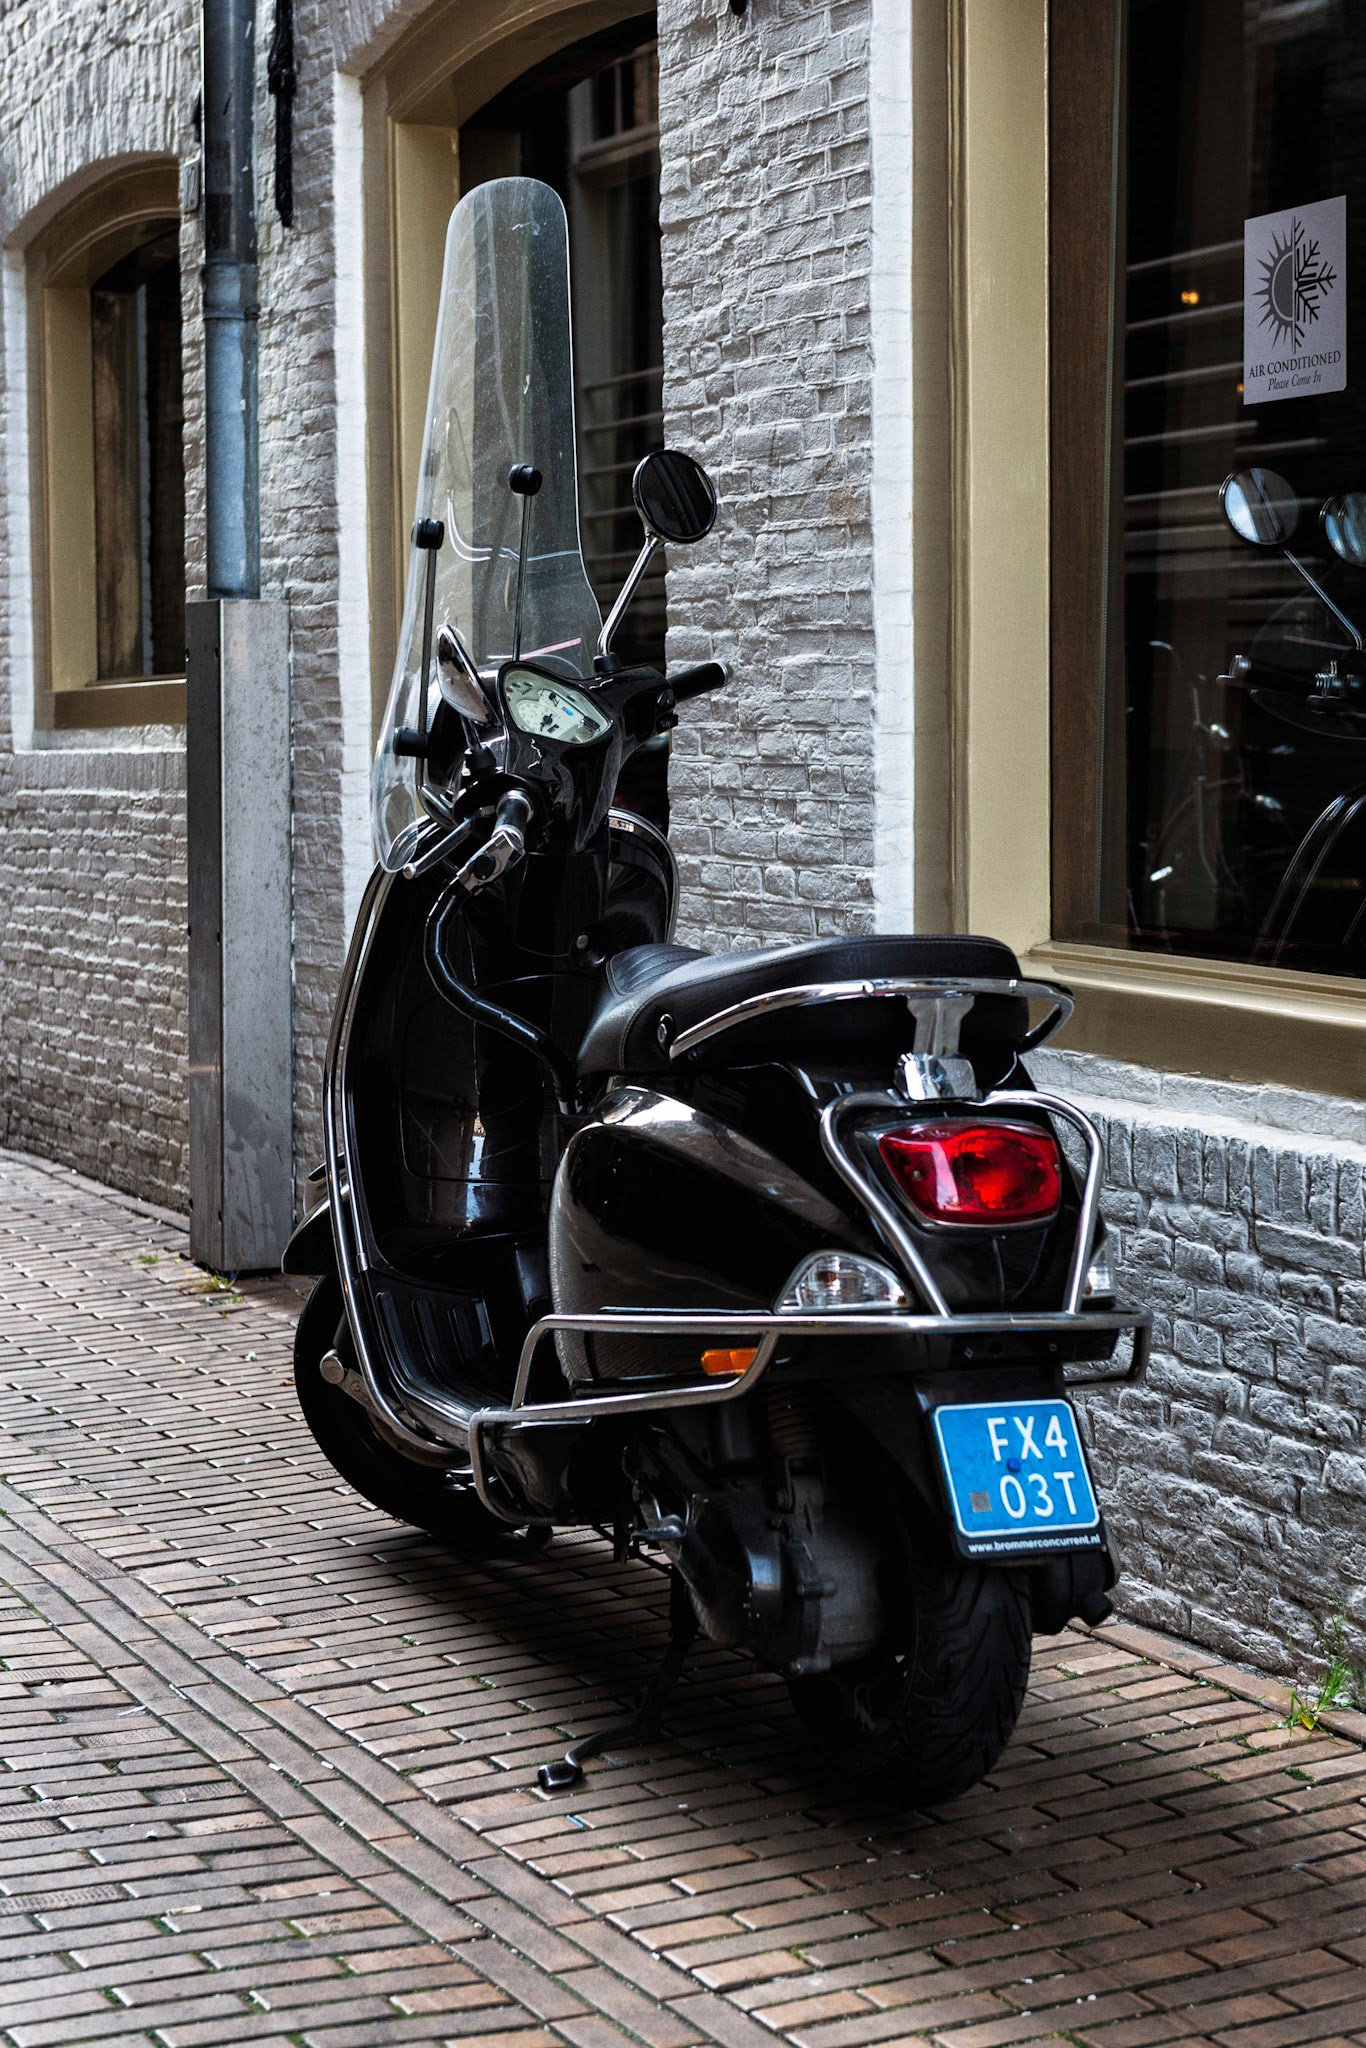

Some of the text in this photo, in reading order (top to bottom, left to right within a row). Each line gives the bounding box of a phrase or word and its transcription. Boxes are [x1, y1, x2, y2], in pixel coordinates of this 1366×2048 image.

[1249, 351, 1341, 378] AIR CONDITIONED
[1268, 370, 1321, 391] Please Come In
[987, 1415, 1067, 1462] FX4
[1000, 1471, 1077, 1518] 03T
[968, 1534, 1100, 1552] www.brommerconcurrent.nl
